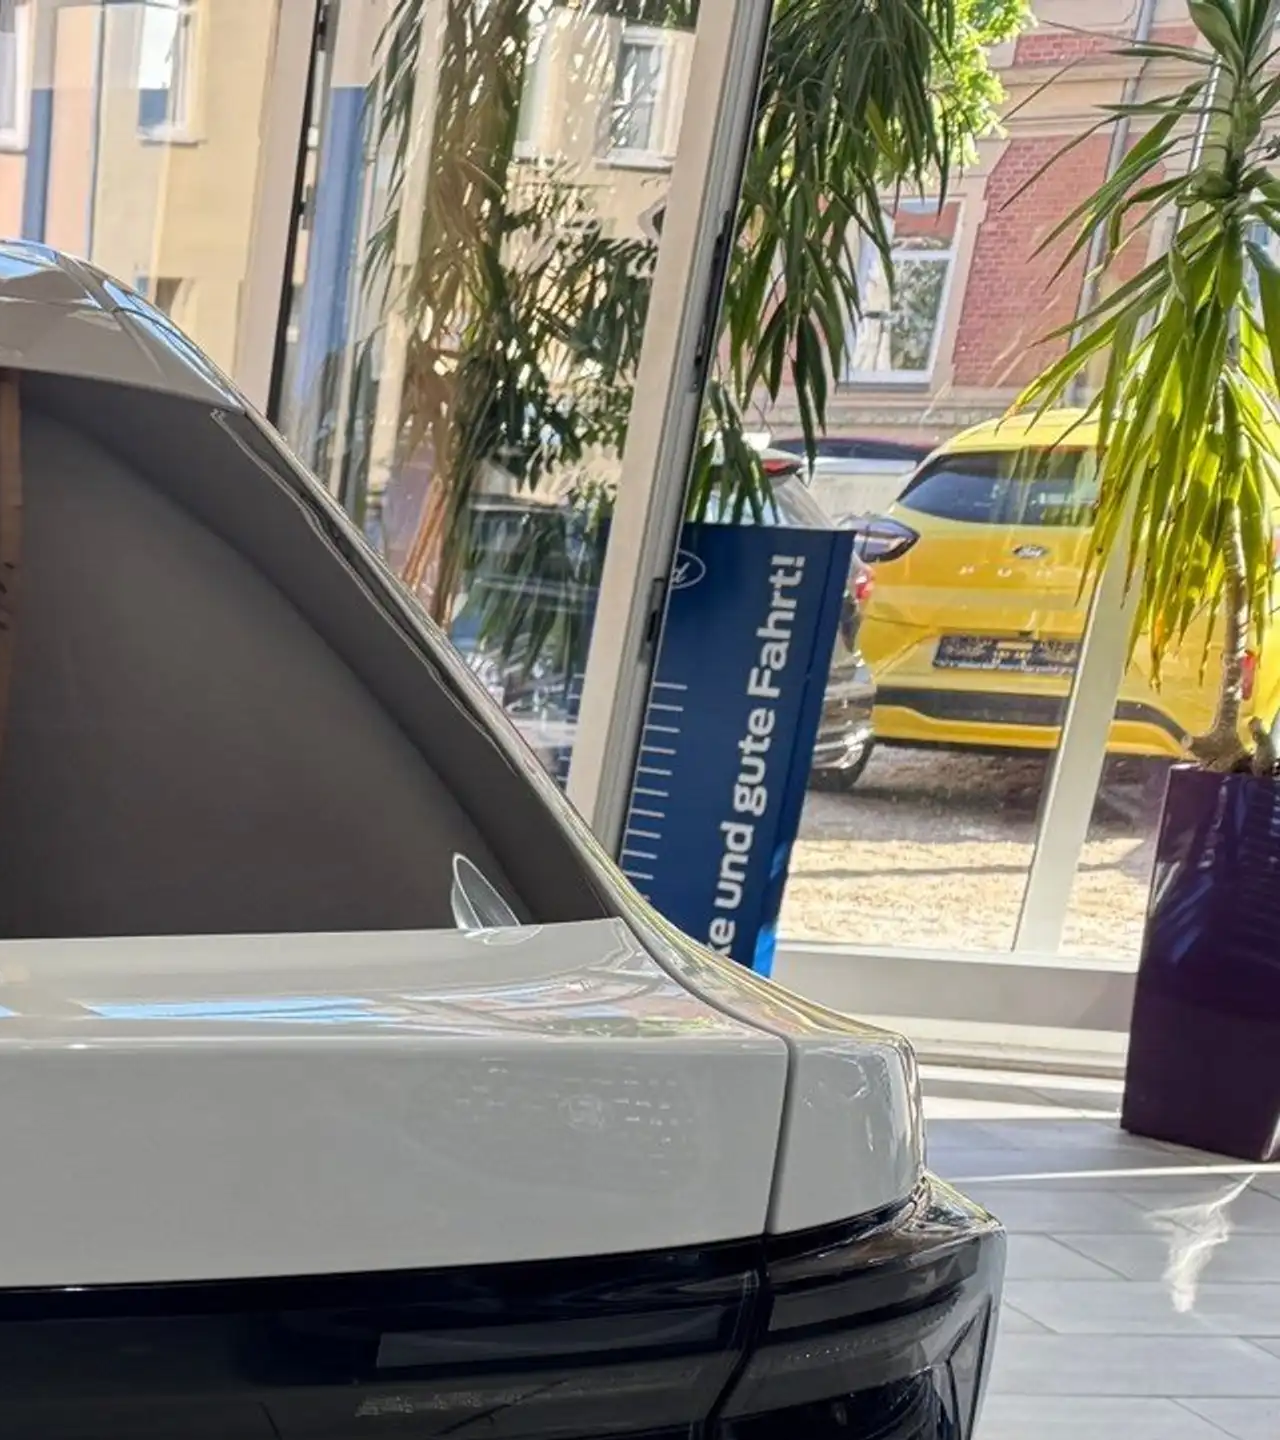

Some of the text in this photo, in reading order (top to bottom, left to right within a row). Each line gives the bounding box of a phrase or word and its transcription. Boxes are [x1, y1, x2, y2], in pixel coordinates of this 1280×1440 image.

[747, 554, 806, 699] Fahrt!
[733, 707, 777, 819] gute
[713, 820, 755, 911] und
